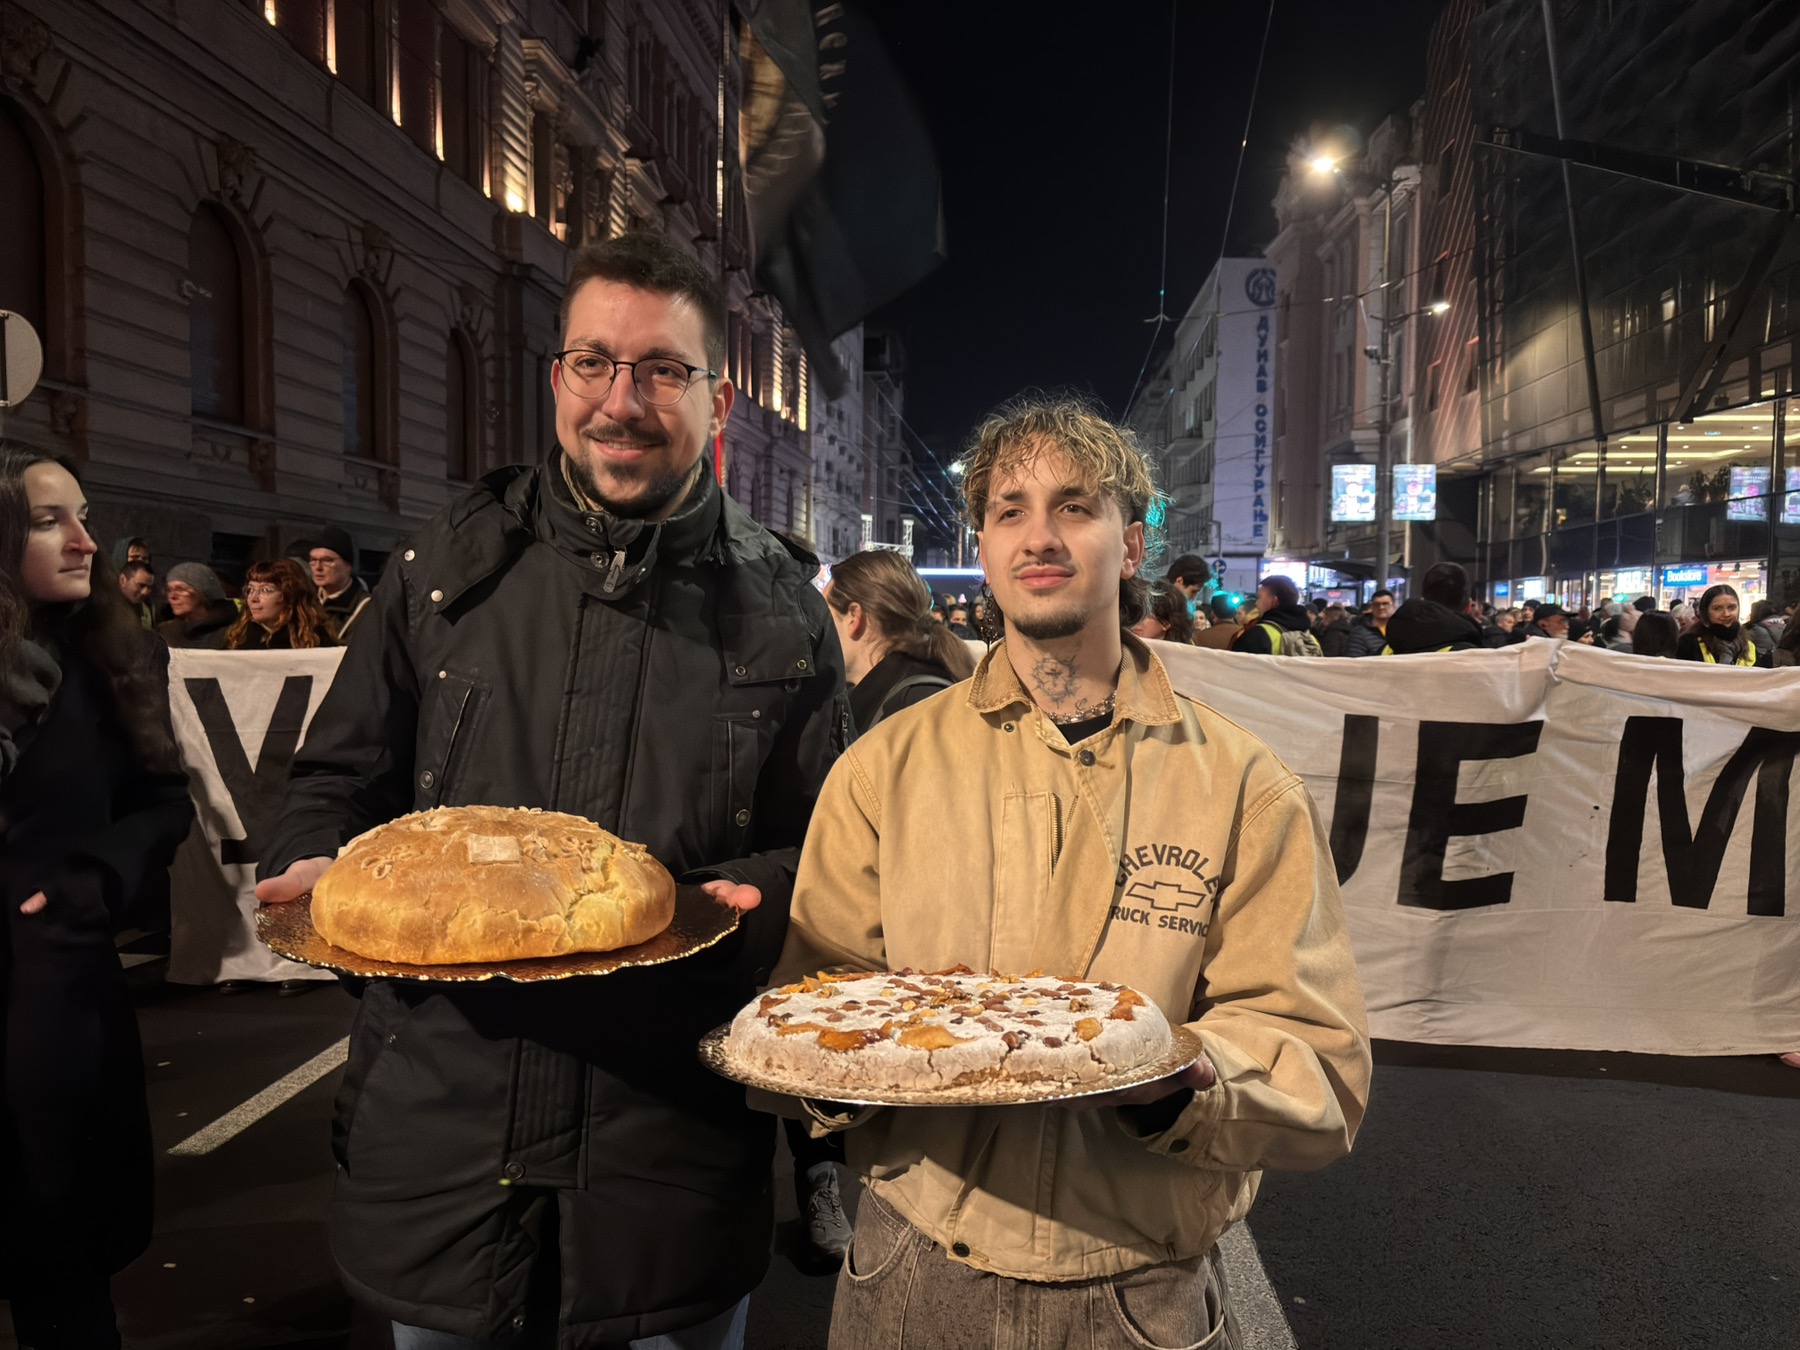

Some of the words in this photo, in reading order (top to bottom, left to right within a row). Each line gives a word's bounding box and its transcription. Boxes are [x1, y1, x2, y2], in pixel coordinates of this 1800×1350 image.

[1256, 315, 1269, 393] ДУНАВ
[1253, 403, 1269, 537] ОСИГУРАЊЕ
[1667, 570, 1702, 582] Bookstore
[1114, 843, 1221, 904] CHEVROLE
[1109, 905, 1151, 926] RUCK
[1157, 914, 1210, 938] SERVIC
